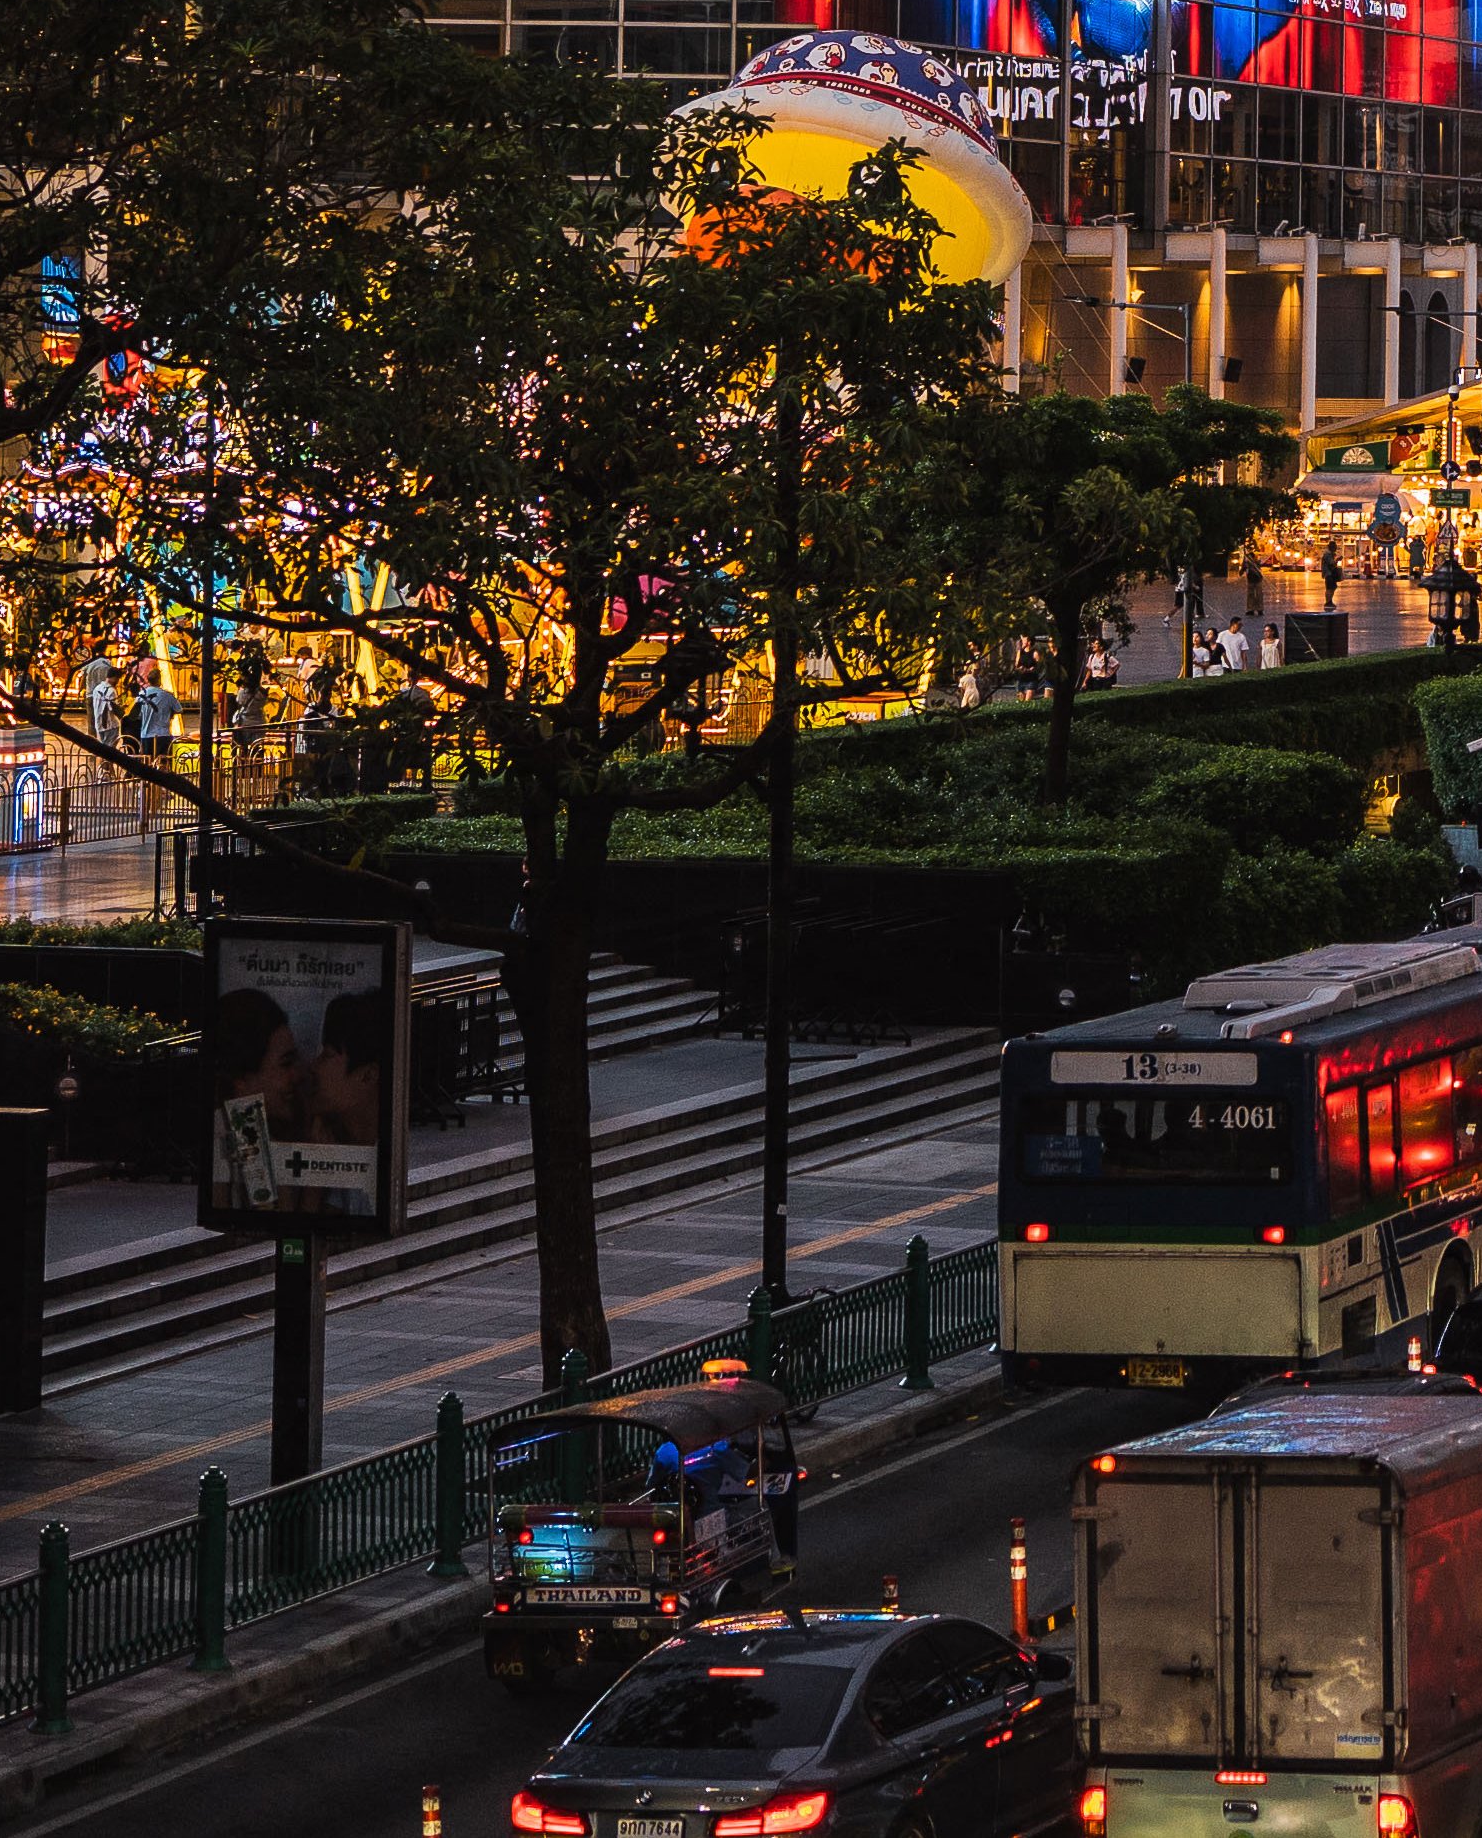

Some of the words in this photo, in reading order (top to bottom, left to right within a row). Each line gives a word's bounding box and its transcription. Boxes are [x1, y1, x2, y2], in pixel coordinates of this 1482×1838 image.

[1121, 1054, 1158, 1081] 13
[1164, 1062, 1202, 1077] (3-38)
[534, 1588, 643, 1603] THAILAND
[646, 1820, 681, 1837] 7644
